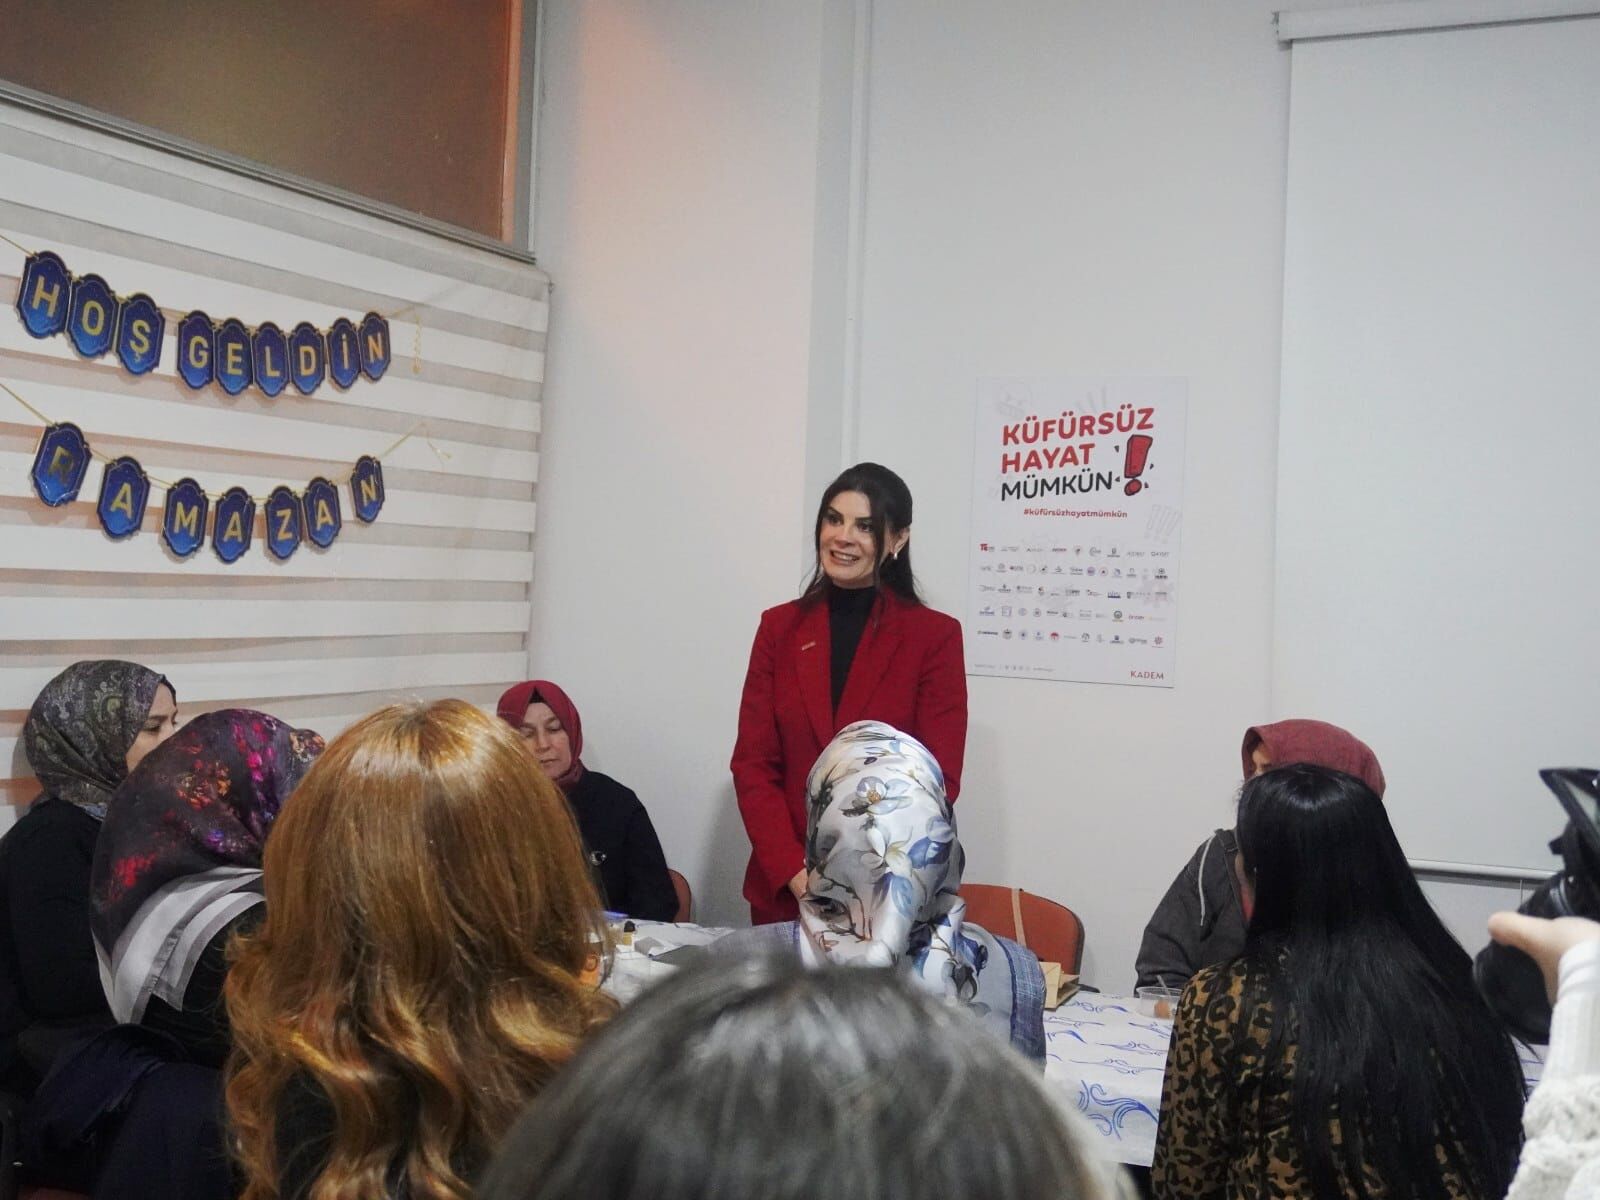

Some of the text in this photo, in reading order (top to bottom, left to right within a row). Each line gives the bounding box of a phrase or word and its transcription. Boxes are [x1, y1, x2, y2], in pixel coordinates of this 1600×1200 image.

[31, 276, 384, 378] HOŞ GELDİN
[1002, 403, 1155, 446] KÜFÜRSÜZ
[1001, 443, 1096, 474] HAYAT
[47, 445, 376, 543] RAMAZAN
[1001, 468, 1113, 501] MÜMKÜN
[1023, 507, 1128, 519] #küfürsüzhayatmümkün
[1130, 670, 1165, 680] KADEM
